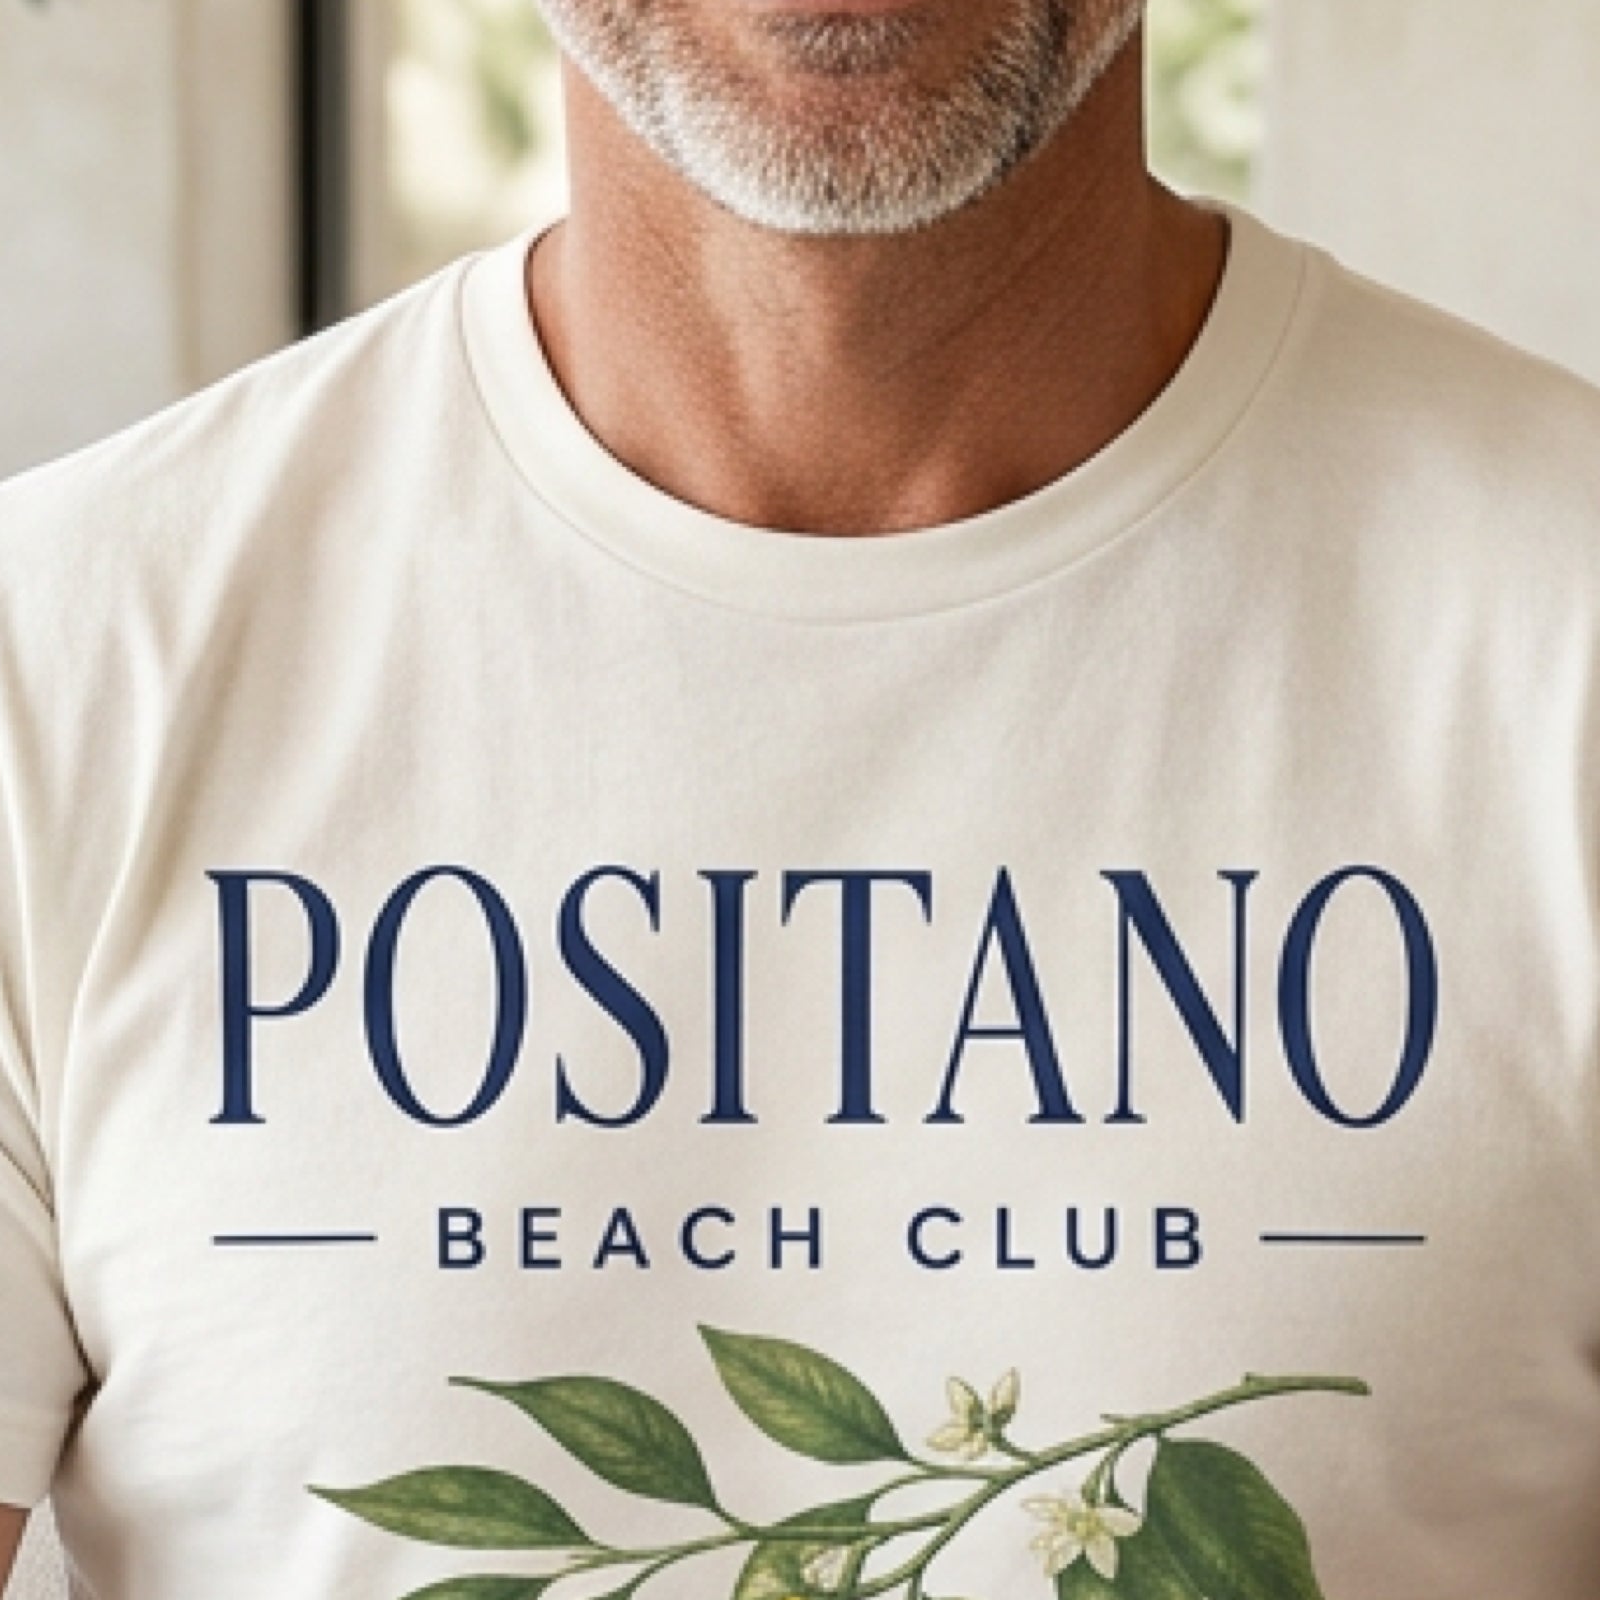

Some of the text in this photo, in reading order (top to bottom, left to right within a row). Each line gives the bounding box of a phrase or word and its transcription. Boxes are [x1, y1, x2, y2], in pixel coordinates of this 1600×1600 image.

[205, 865, 1439, 1129] POSITANO
[437, 1207, 1203, 1270] BEACH CLUB
